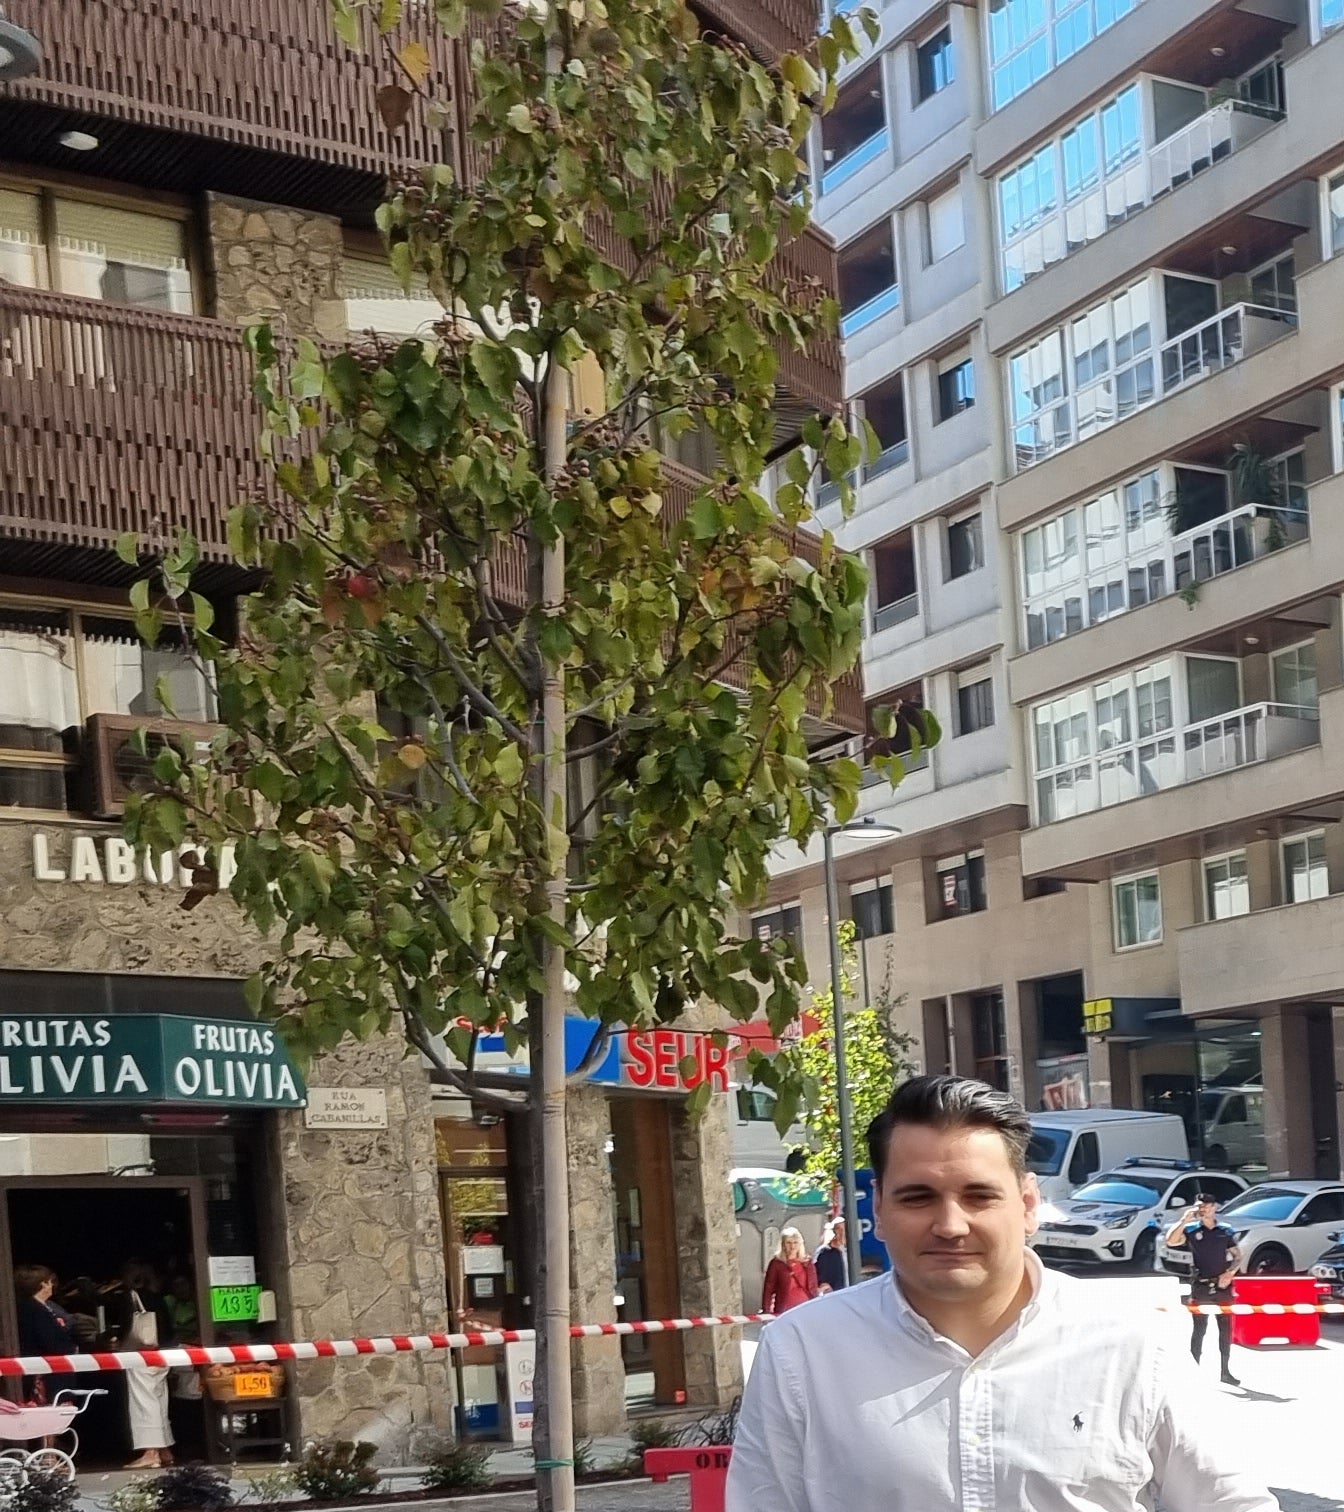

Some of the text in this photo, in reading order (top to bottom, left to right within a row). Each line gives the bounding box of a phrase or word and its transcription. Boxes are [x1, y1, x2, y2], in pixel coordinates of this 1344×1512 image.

[193, 1023, 275, 1056] FRUTAS
[625, 1023, 730, 1093] SEUR
[174, 1056, 300, 1101] OLIVIA
